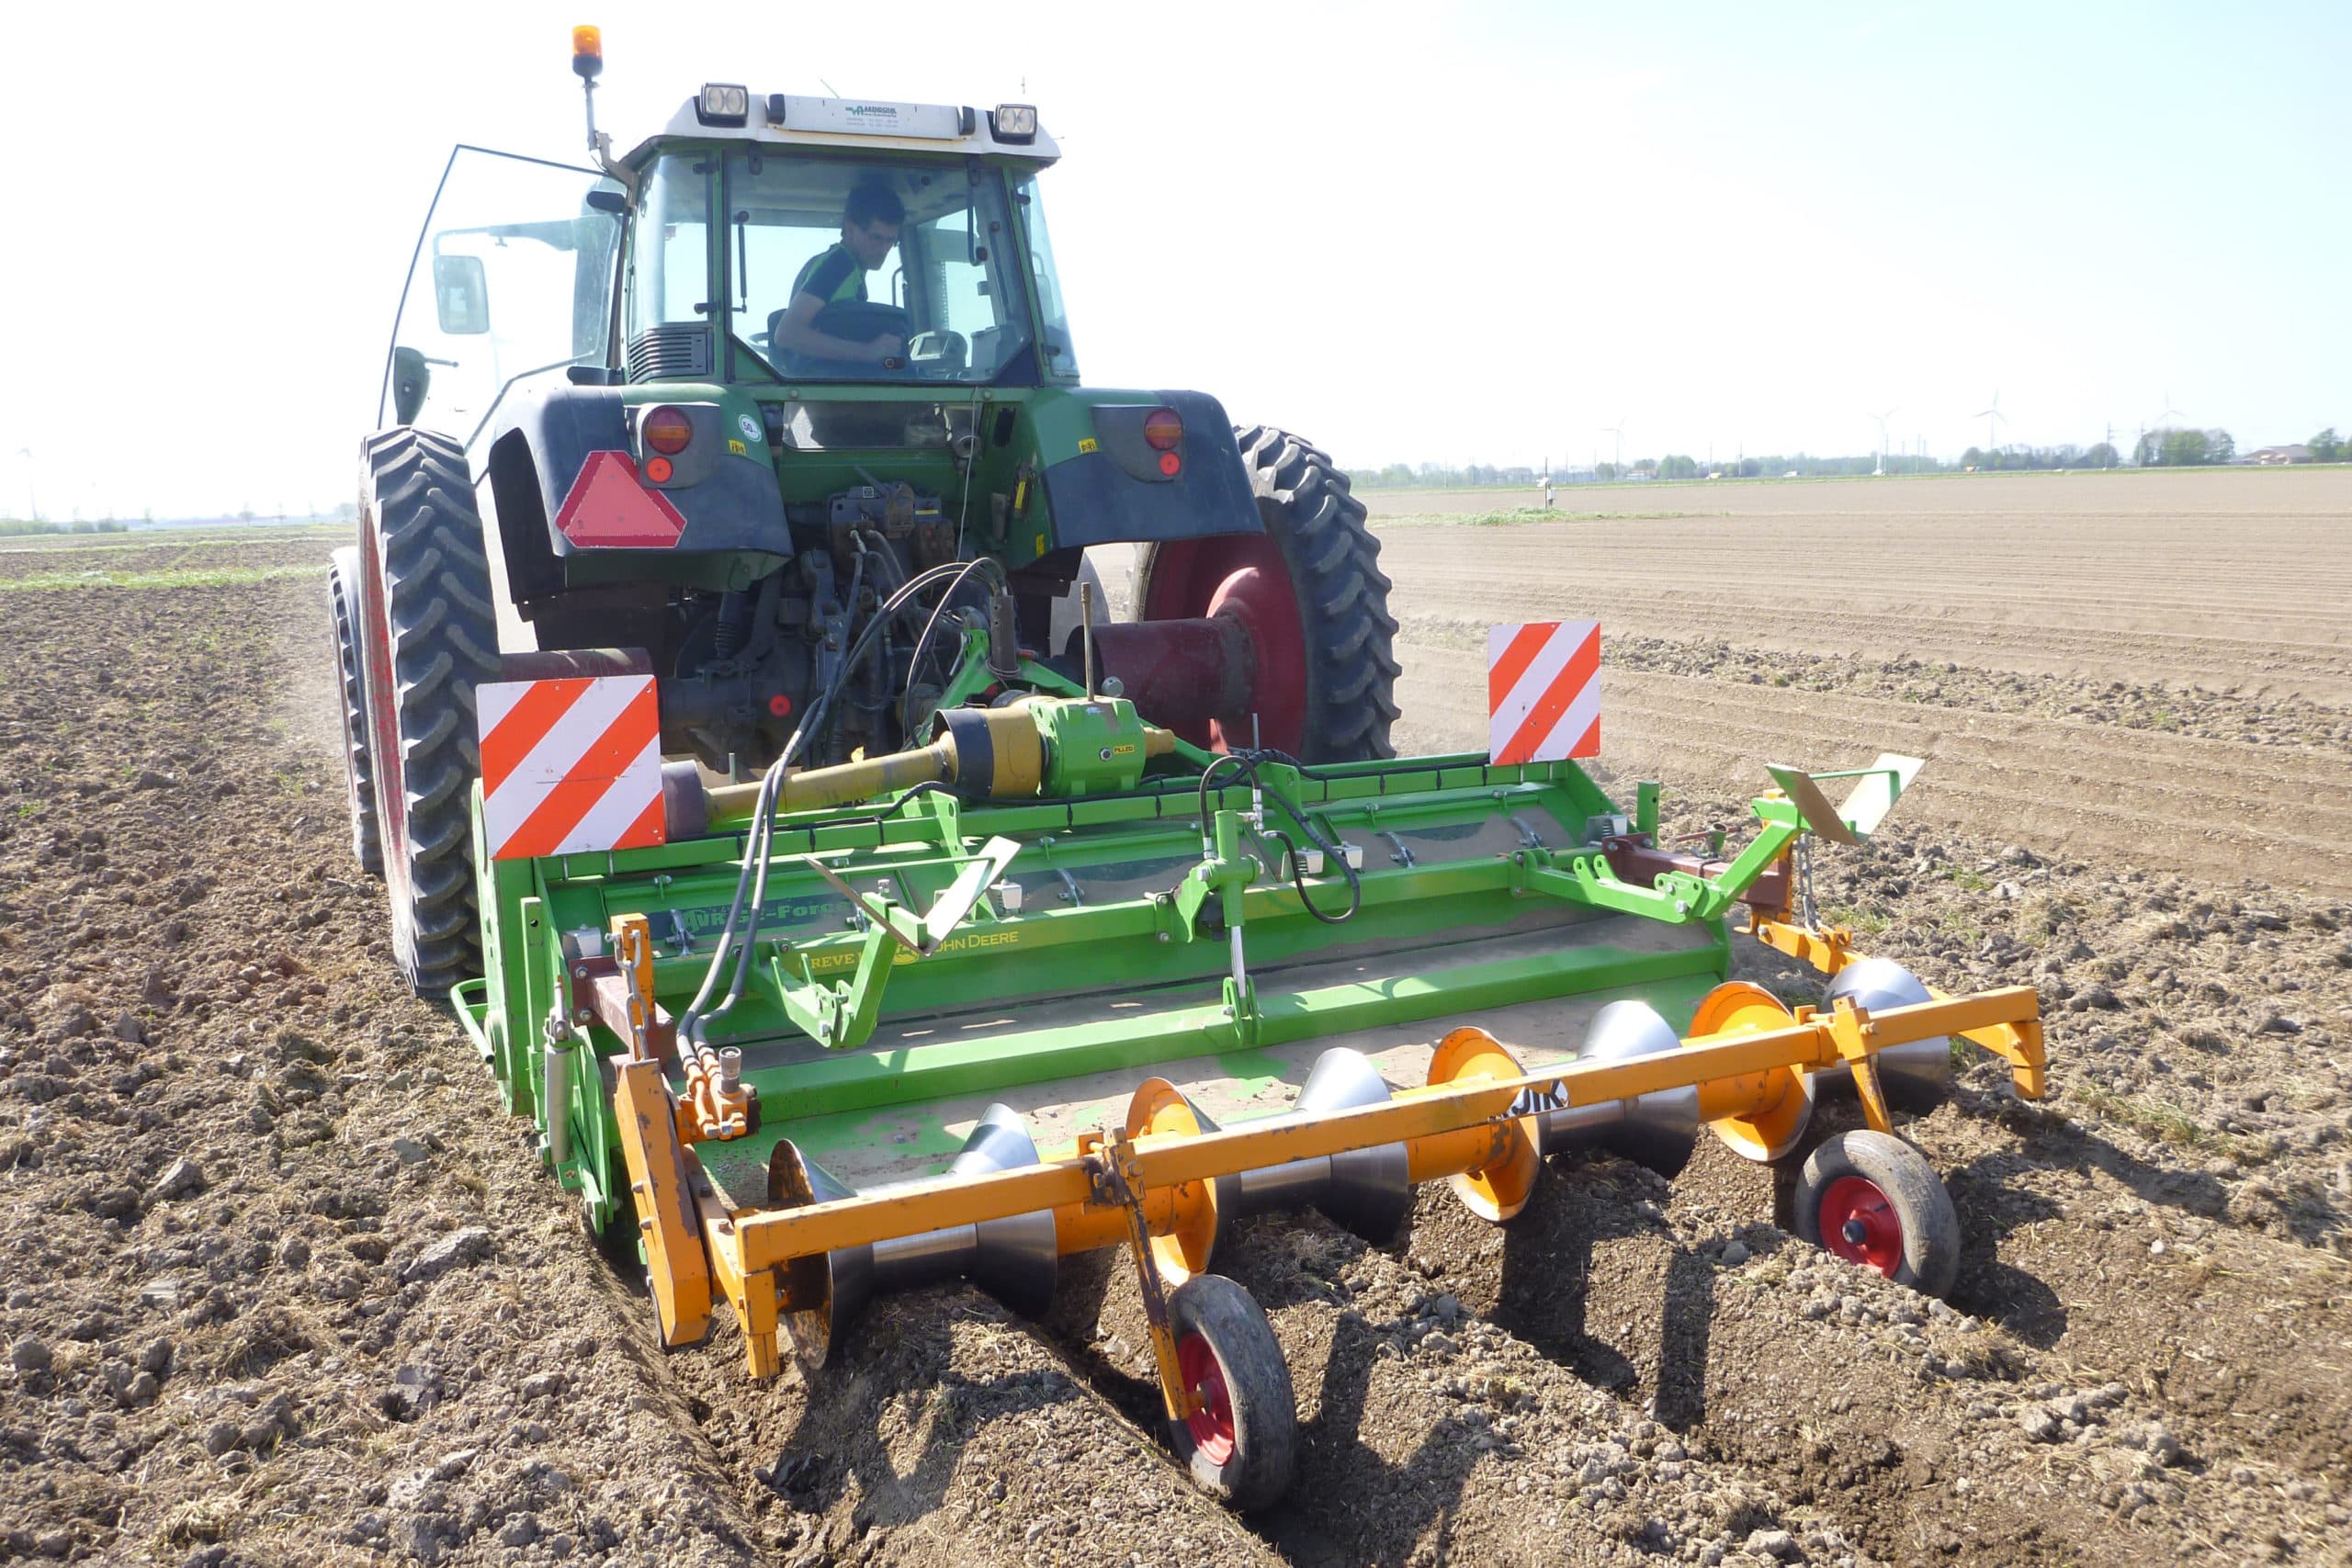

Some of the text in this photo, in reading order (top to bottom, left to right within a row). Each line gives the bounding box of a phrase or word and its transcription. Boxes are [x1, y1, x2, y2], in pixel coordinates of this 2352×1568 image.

[935, 931, 1019, 953] OHN DEERE
[798, 953, 854, 969] REVE
